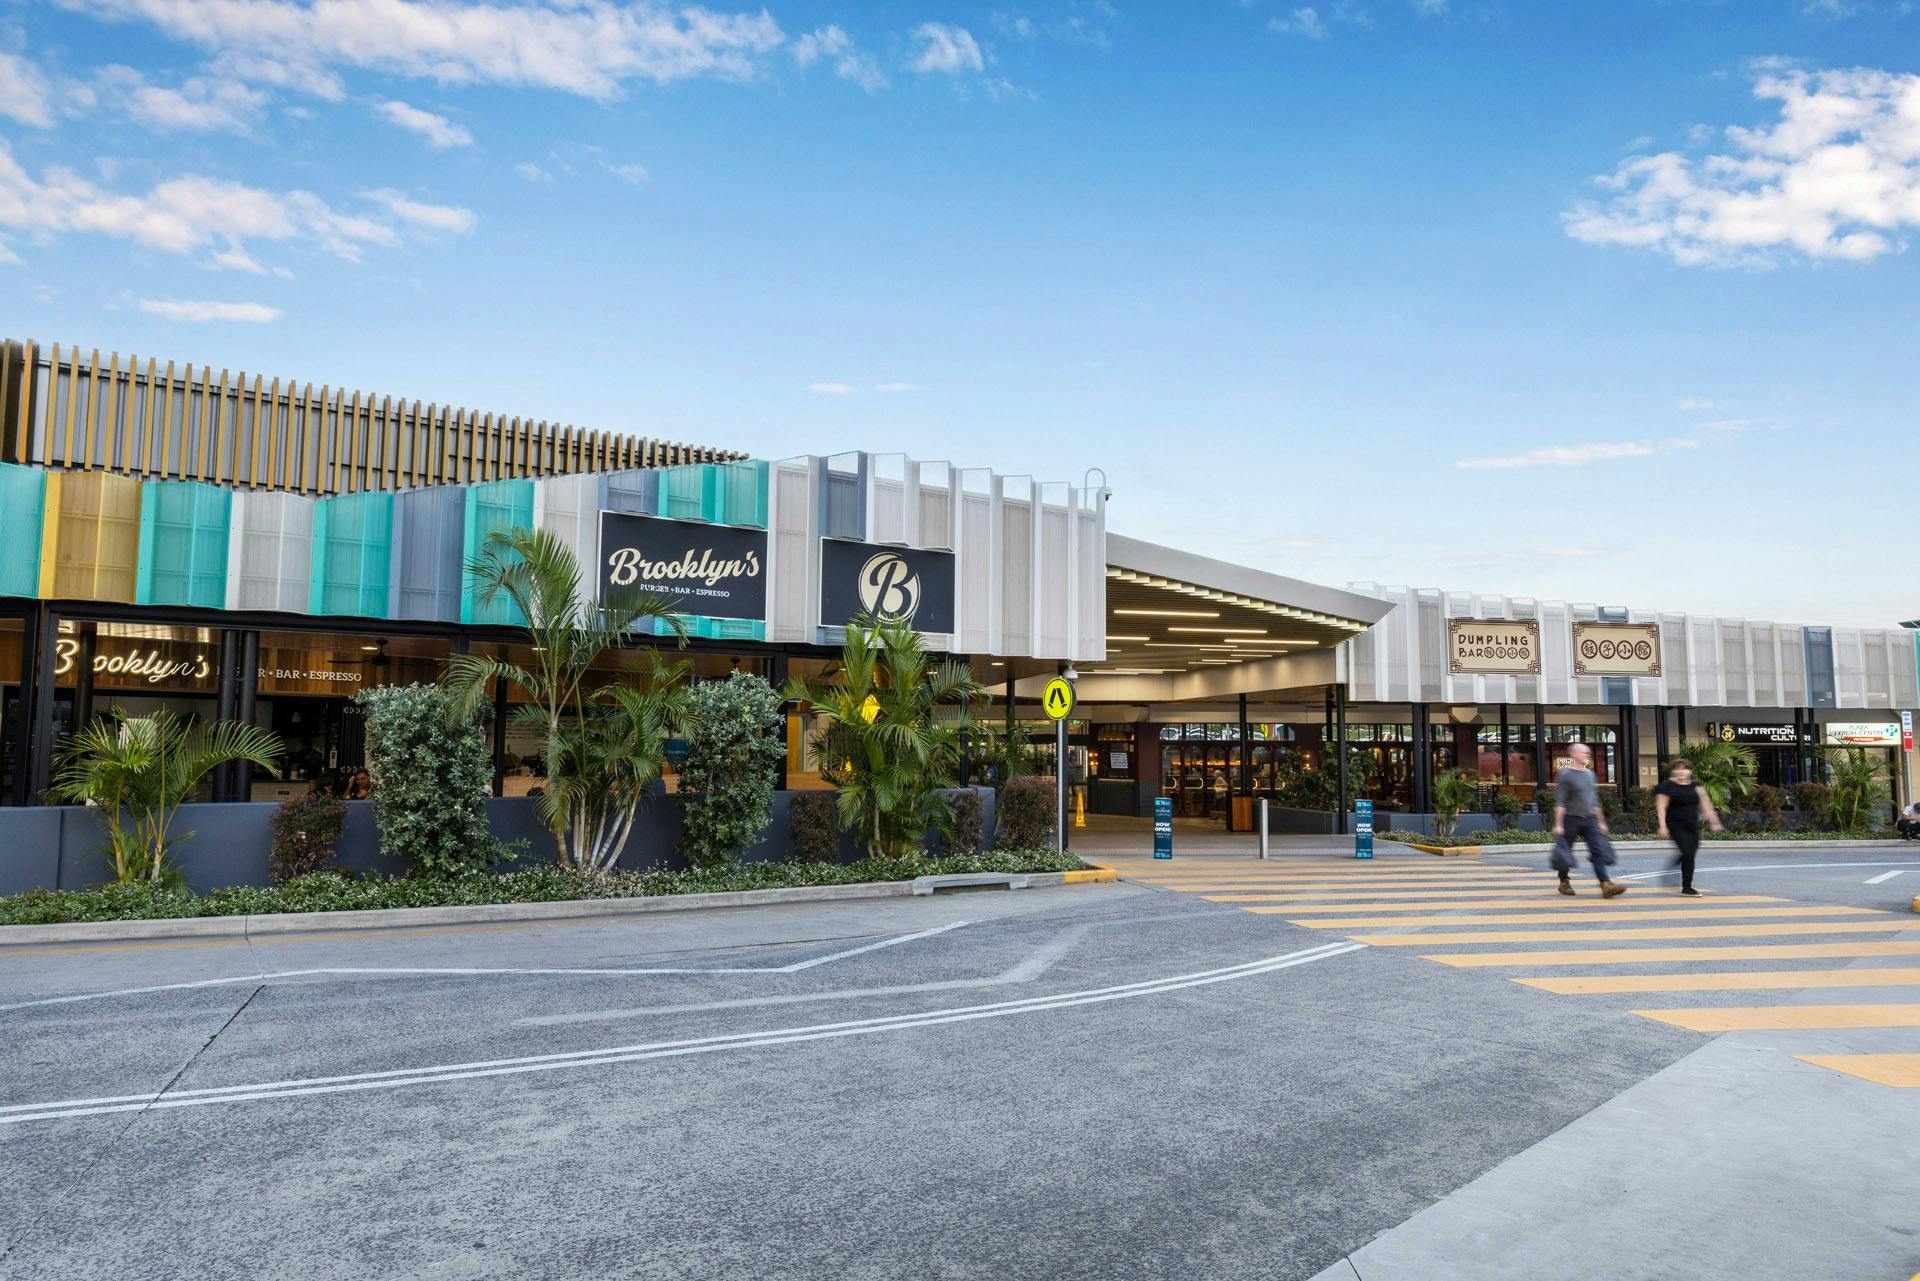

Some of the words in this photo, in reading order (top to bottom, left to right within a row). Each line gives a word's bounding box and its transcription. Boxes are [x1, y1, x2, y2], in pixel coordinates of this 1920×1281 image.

[608, 547, 760, 587] Brooklyn's
[675, 586, 691, 595] BAR
[695, 588, 730, 598] ESPRESSO
[1458, 634, 1528, 645] DUMPLING
[1458, 647, 1484, 658] BAR
[54, 638, 210, 683] Booklyn's
[275, 669, 301, 679] BAR
[309, 670, 362, 682] ESPRESSO
[1738, 727, 1795, 735] NUTRITION
